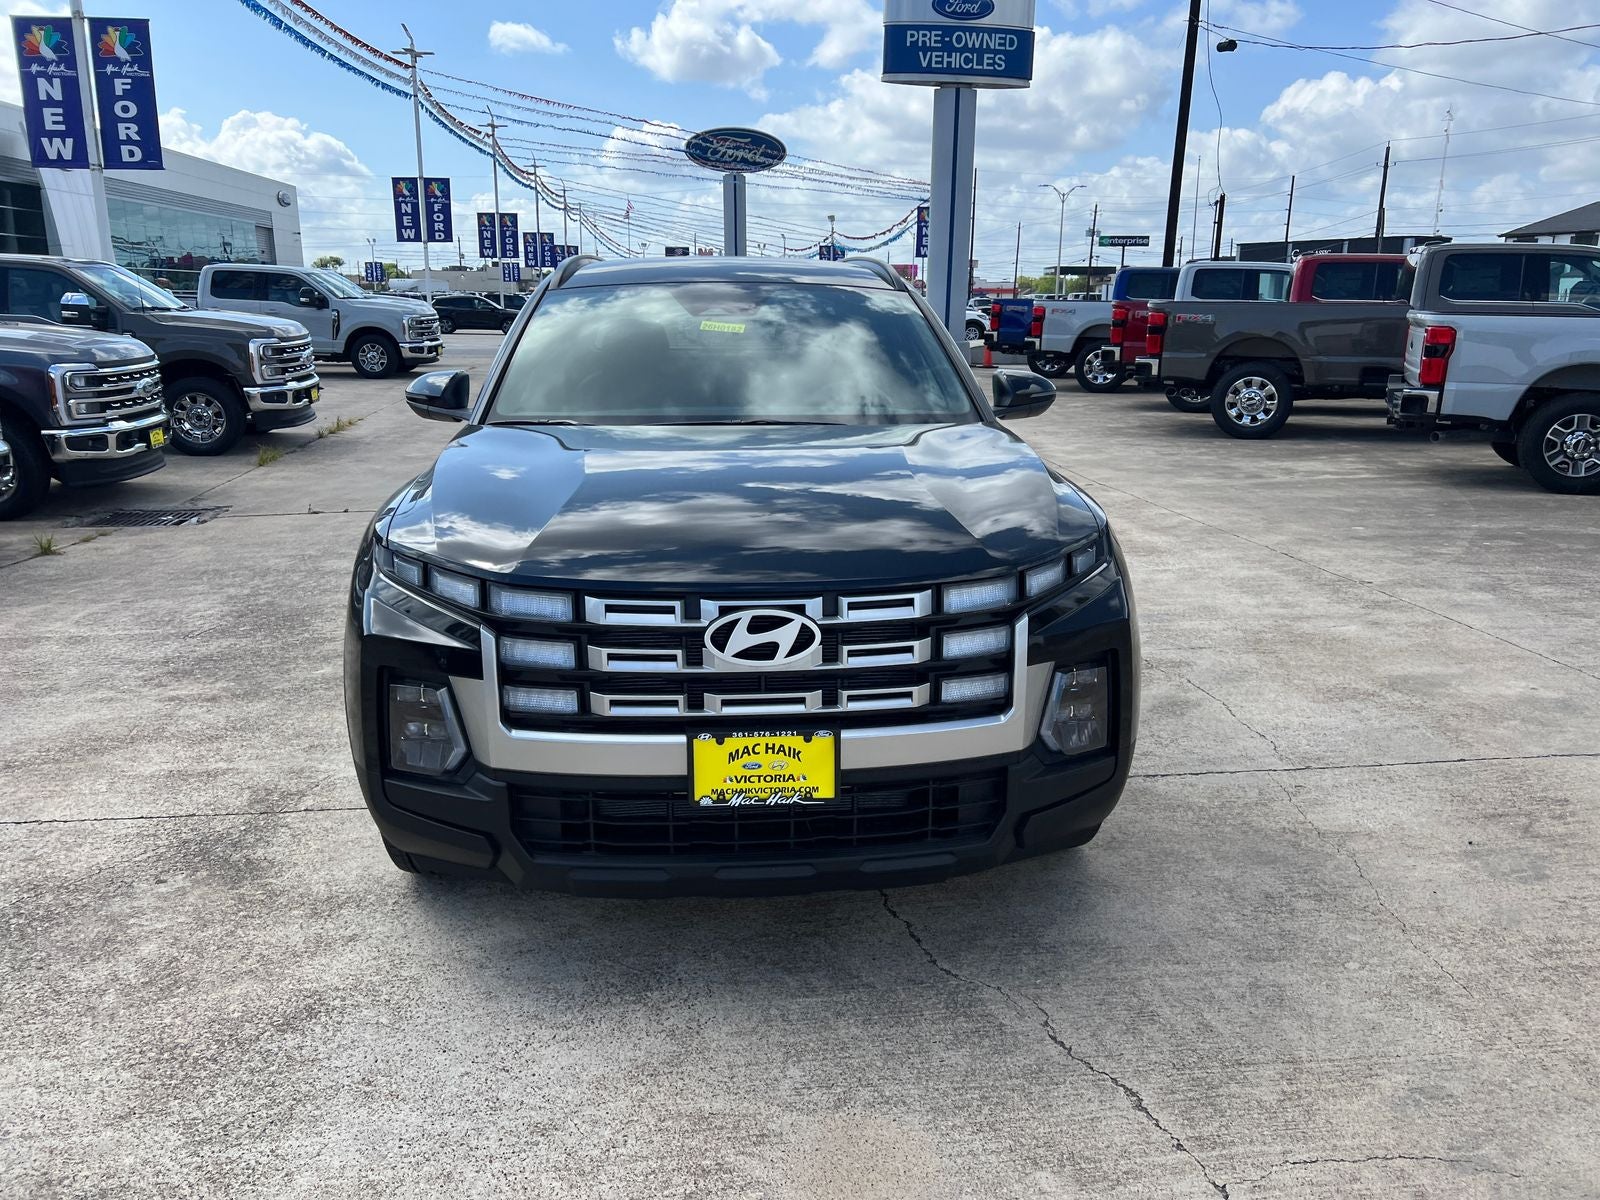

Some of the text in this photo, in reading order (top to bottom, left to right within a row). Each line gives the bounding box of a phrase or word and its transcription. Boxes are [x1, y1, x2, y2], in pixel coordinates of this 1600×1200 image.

[945, 0, 981, 13] Ford
[918, 51, 1006, 71] VEHICLES
[36, 77, 74, 161] NEW
[113, 78, 143, 163] FORD
[400, 202, 416, 239] NEW
[432, 203, 445, 240] FORD
[483, 230, 493, 257] NEW
[505, 230, 514, 258] FORD
[1103, 237, 1149, 246] enterprise
[526, 246, 536, 266] NEW
[1175, 313, 1213, 323] FX4
[732, 730, 797, 738] 361-576-1221
[728, 742, 802, 765] MAC HAIK
[734, 774, 796, 784] VICTORIA
